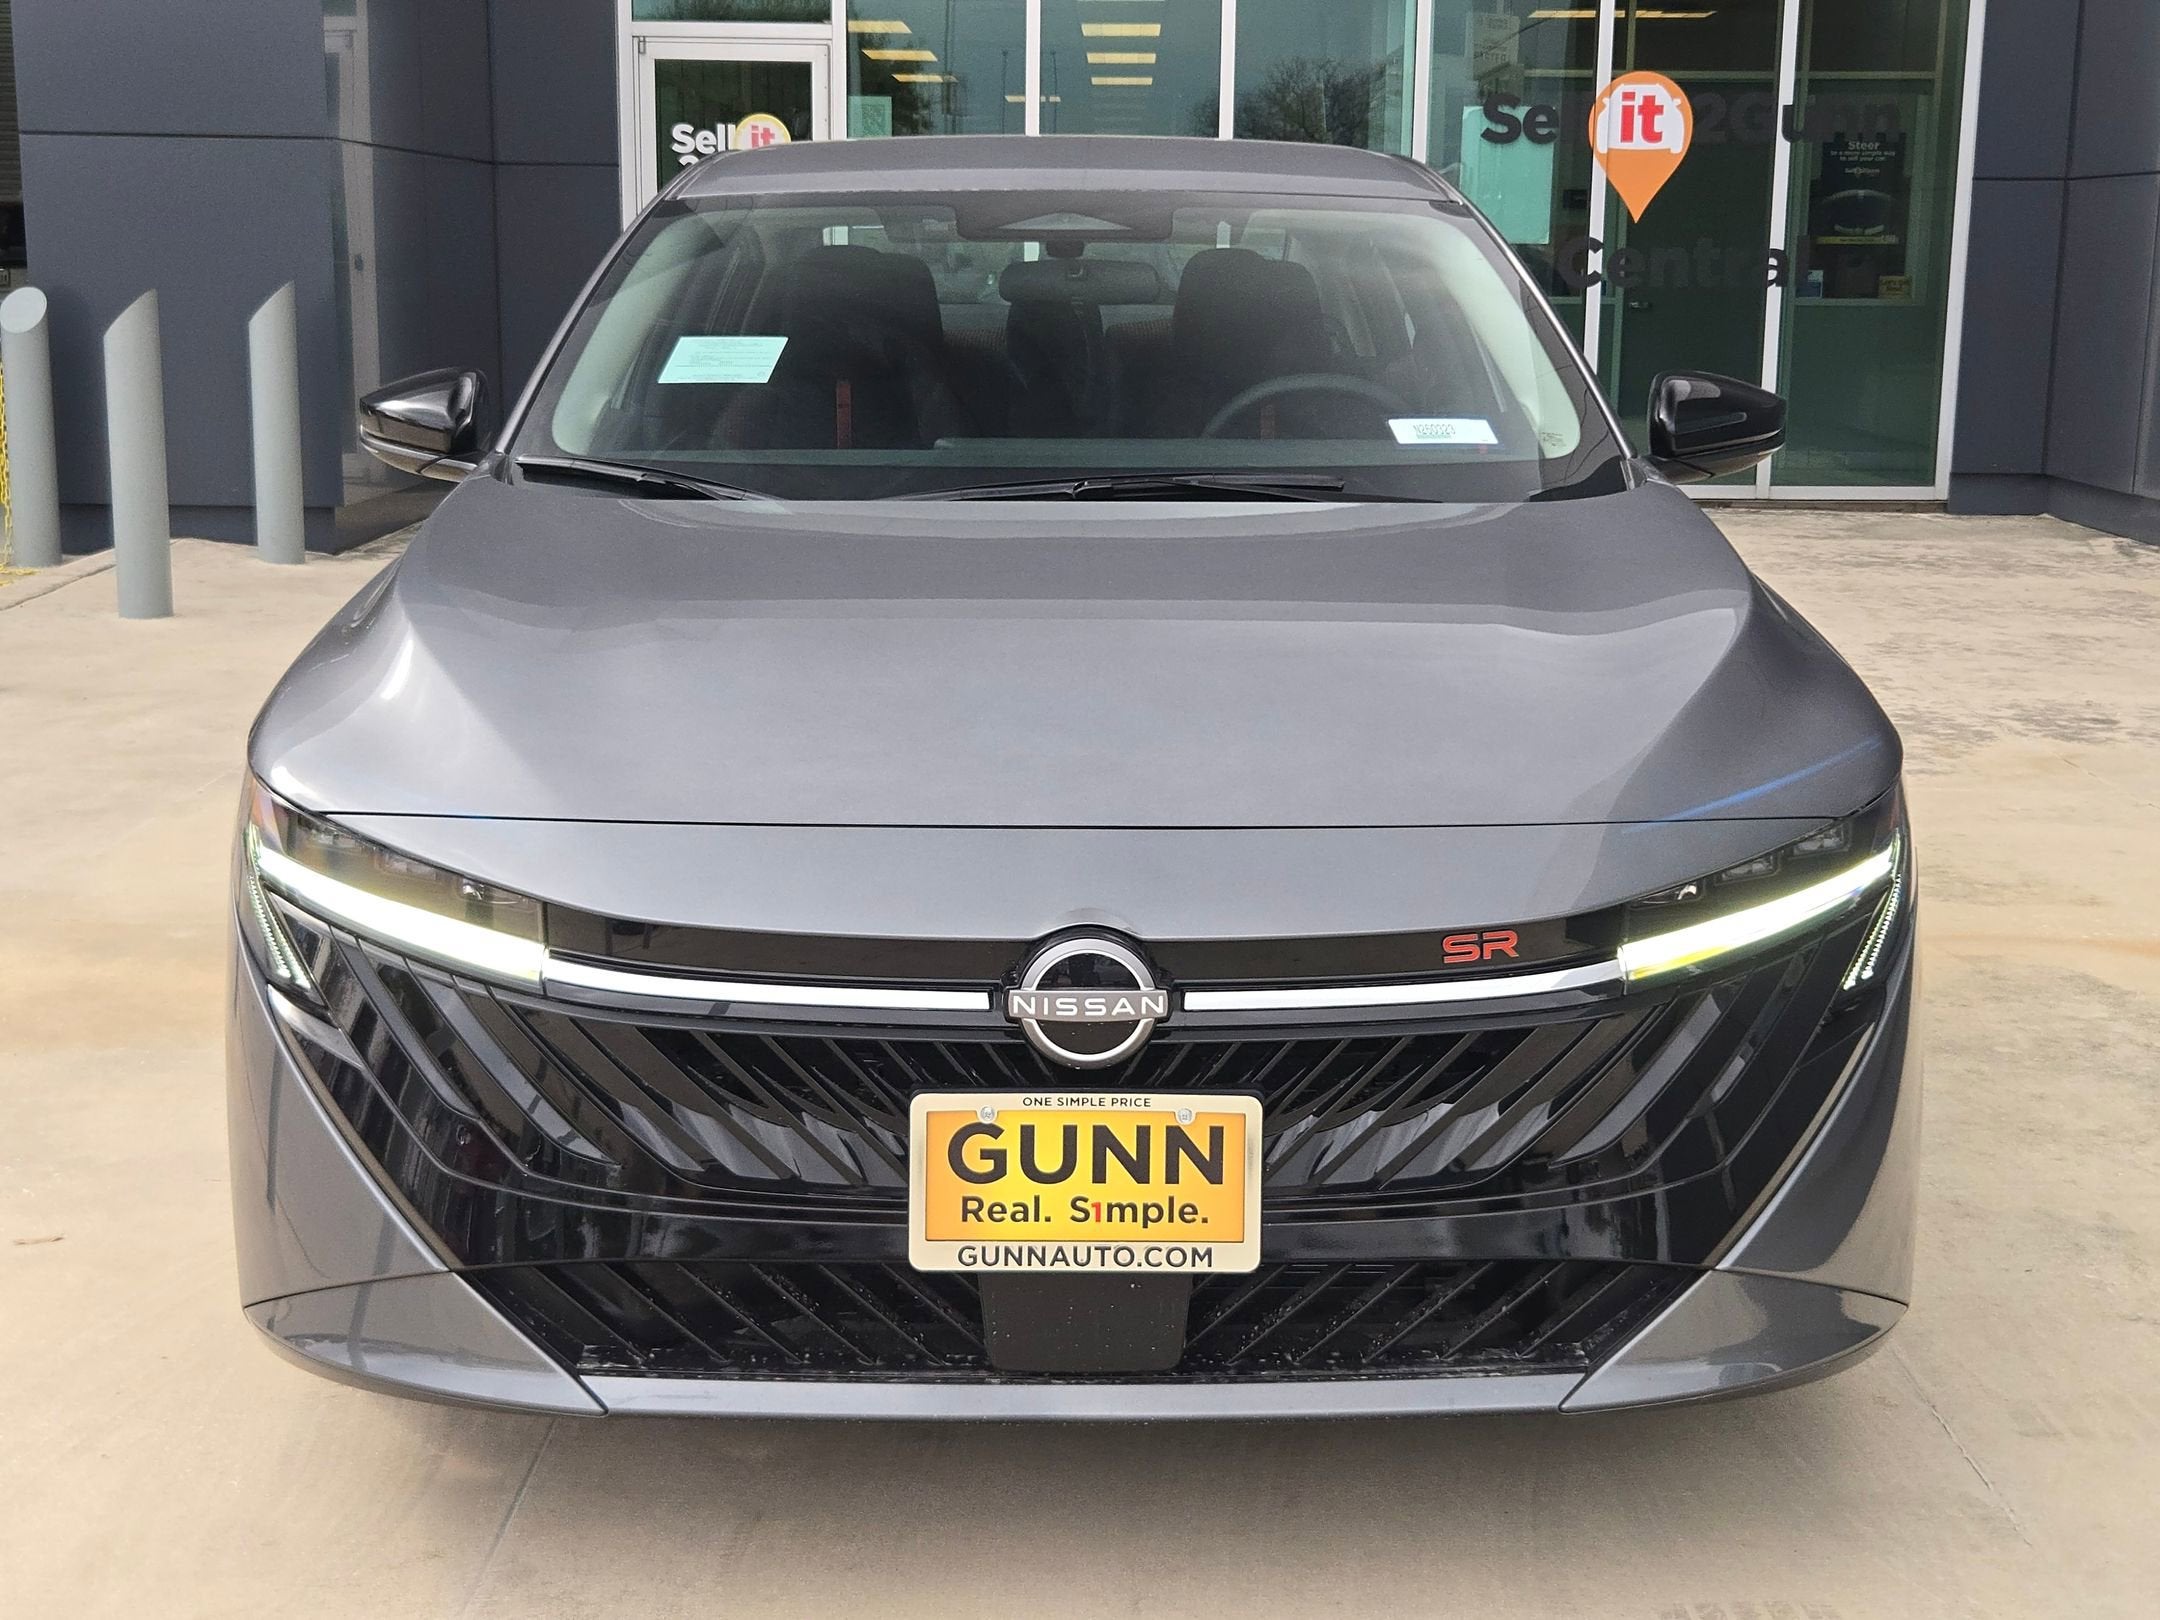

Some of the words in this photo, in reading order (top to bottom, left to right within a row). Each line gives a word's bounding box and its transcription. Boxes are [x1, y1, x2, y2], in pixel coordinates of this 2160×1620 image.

[1620, 91, 1665, 144] it
[671, 123, 736, 155] Sell
[750, 124, 776, 149] it
[1847, 141, 1880, 150] Steer
[1442, 929, 1519, 964] SR
[1014, 996, 1163, 1015] NISSAN
[1022, 1096, 1052, 1107] ONE
[1057, 1097, 1106, 1107] SIMPLE
[1111, 1097, 1151, 1108] PRICE
[947, 1122, 1224, 1185] GUNN
[961, 1195, 1051, 1223] Real.
[957, 1245, 1213, 1268] GUNNAUTO.COM
